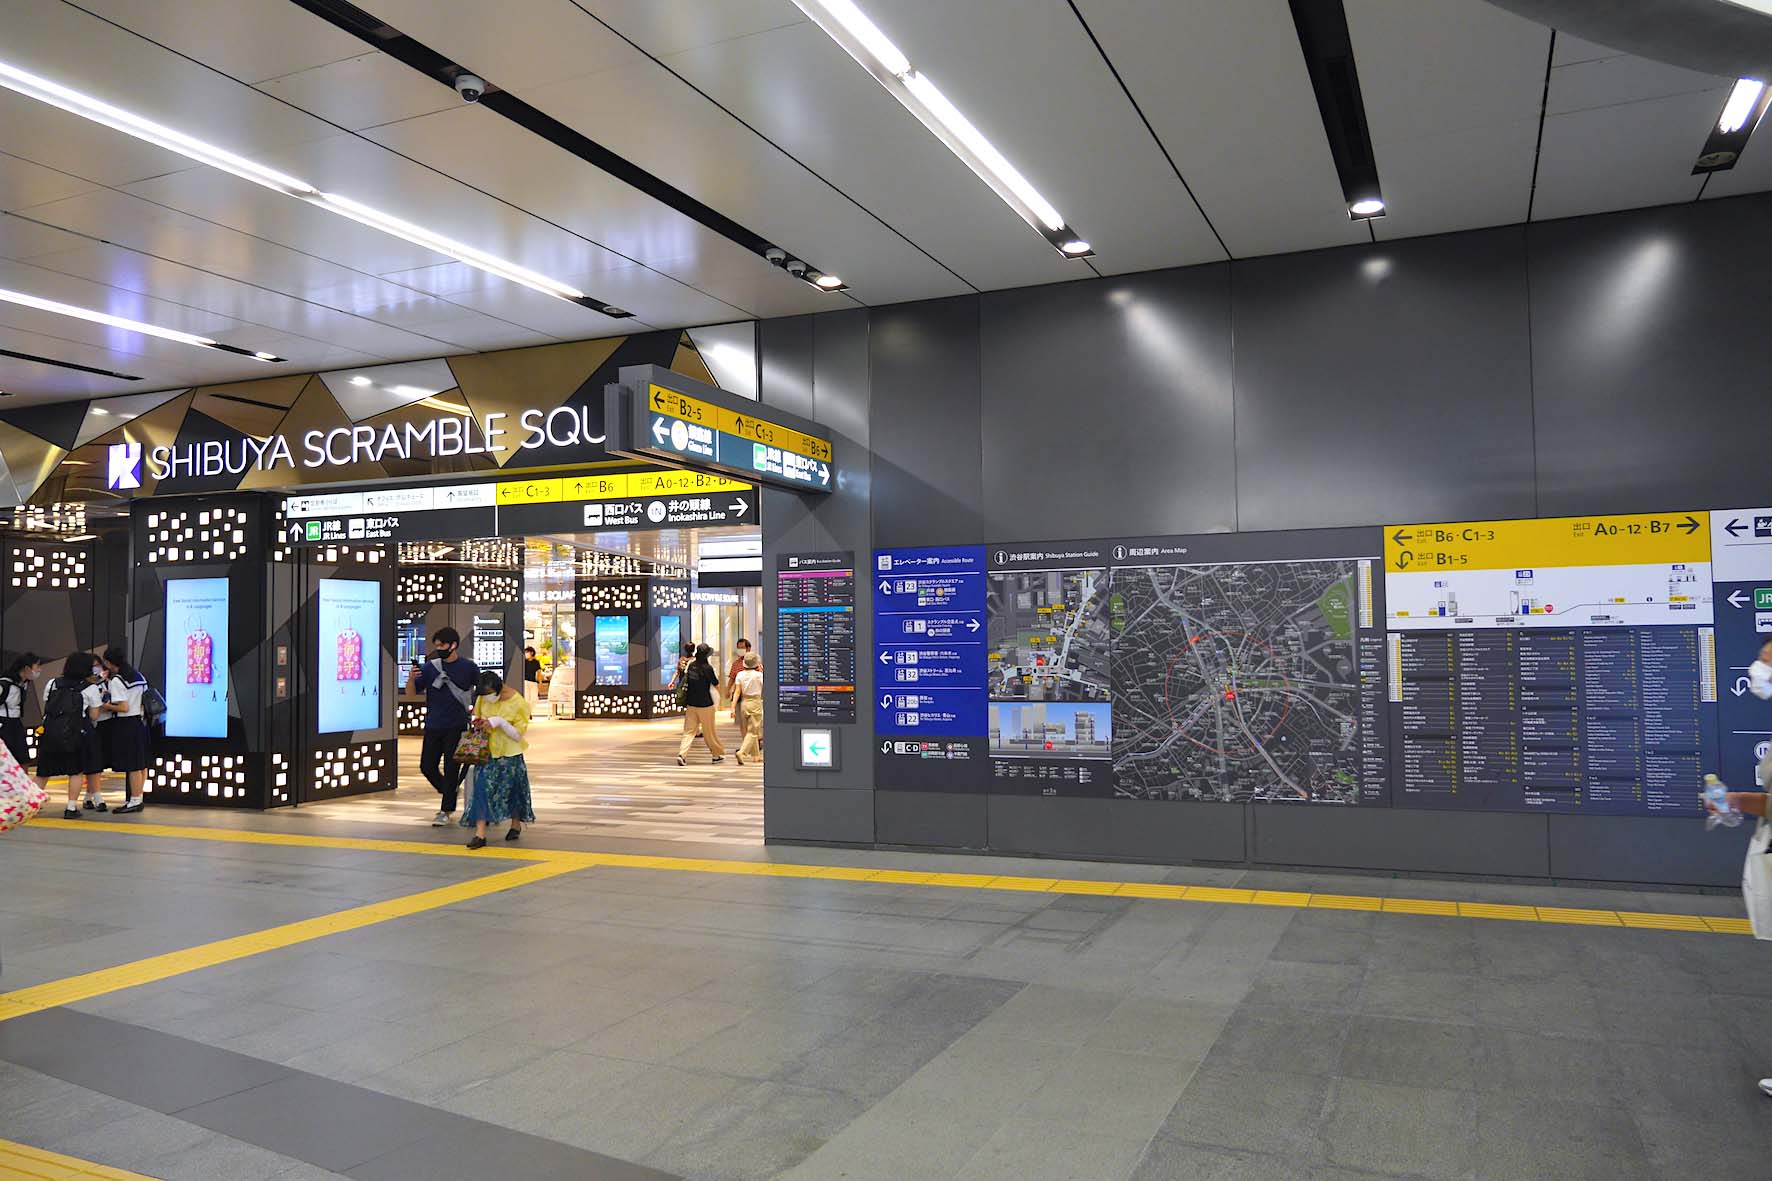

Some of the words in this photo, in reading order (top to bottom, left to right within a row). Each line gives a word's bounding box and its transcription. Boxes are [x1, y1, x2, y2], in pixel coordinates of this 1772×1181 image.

[680, 400, 702, 420] B2-5
[756, 424, 774, 442] C1-3
[151, 434, 296, 481] SHIBUYA
[303, 413, 508, 469] SCRAMBLE
[811, 441, 821, 456] B6
[600, 480, 614, 492] B6
[526, 486, 550, 497] C1-3
[604, 502, 643, 516] 西口バス
[605, 516, 623, 526] West
[624, 516, 638, 524] Bus
[668, 513, 708, 522] Inokashira
[709, 512, 726, 520] Line
[366, 518, 399, 529] 東口バス
[1572, 522, 1590, 531] 出口
[308, 526, 318, 536] JR
[322, 532, 330, 540] JR
[331, 532, 346, 540] Lines
[366, 530, 378, 538] East
[380, 529, 392, 537] Bus
[1416, 530, 1432, 538] 出口
[1010, 552, 1044, 562] 渋谷駅案内
[1045, 552, 1064, 560] Shibuya
[1084, 550, 1099, 558] Guide
[1174, 548, 1187, 556] Map
[894, 558, 940, 566] エレベーター案内
[1417, 552, 1433, 561] 出口
[1436, 552, 1468, 566] B1-5
[906, 582, 915, 590] 23
[907, 654, 916, 662] 31
[908, 670, 916, 678] 32
[908, 714, 917, 722] 22
